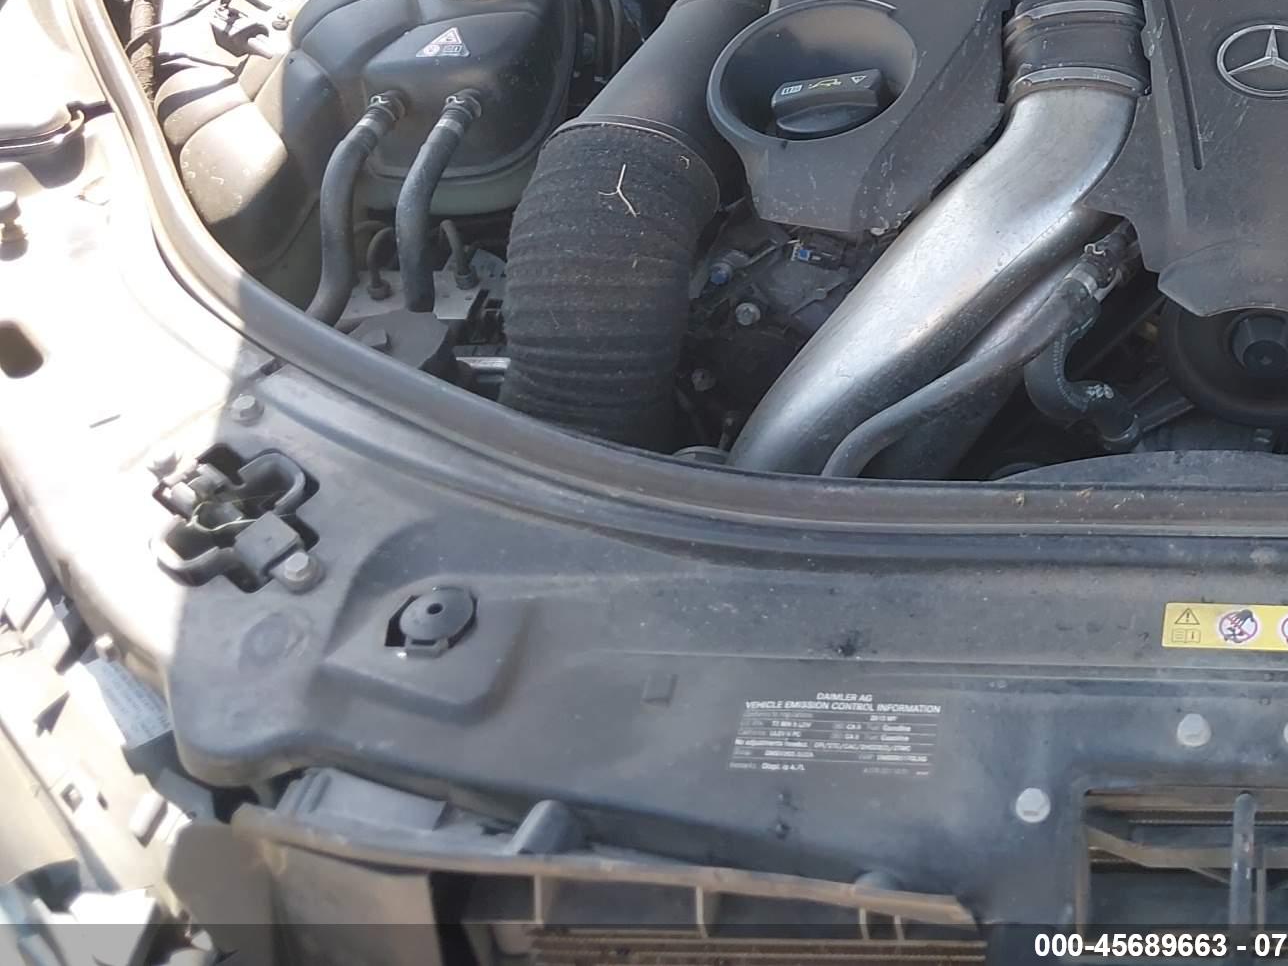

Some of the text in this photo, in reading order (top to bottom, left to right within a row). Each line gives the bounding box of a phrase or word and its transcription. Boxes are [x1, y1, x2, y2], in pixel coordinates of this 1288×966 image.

[816, 692, 872, 702] DAIMLER AG
[745, 701, 941, 713] VEHICLE EMISSION CONTROL INFORMATION
